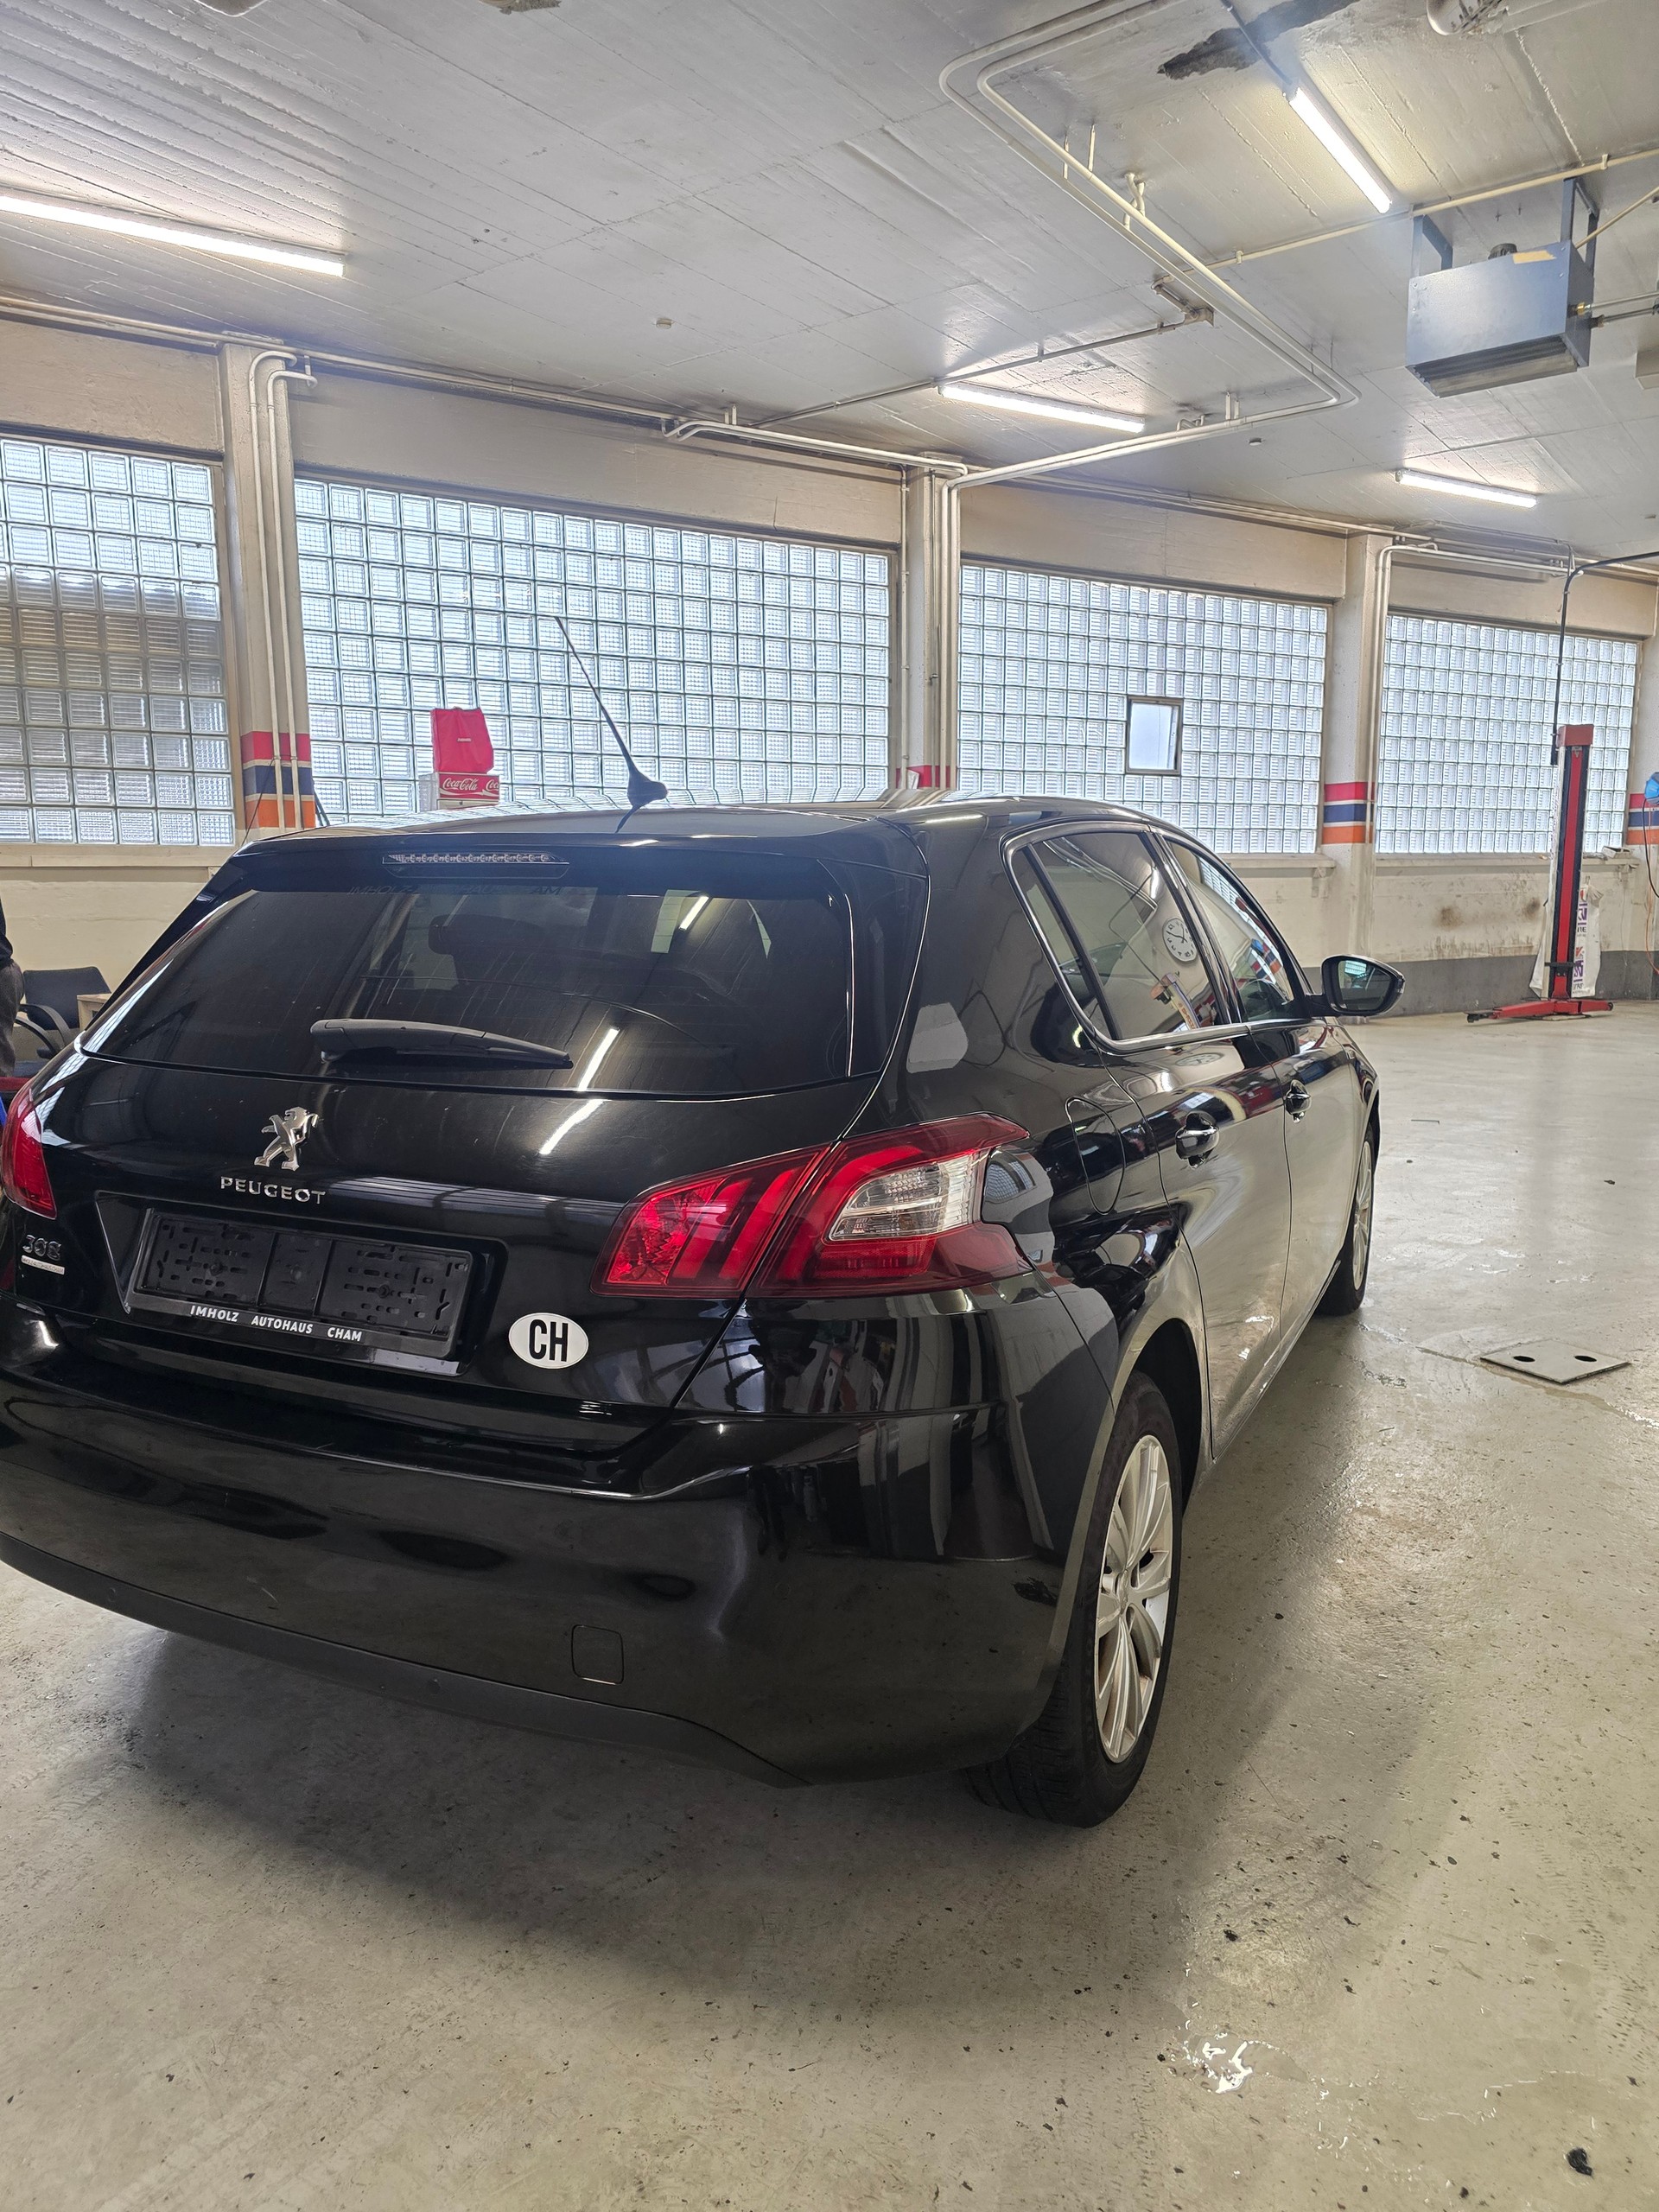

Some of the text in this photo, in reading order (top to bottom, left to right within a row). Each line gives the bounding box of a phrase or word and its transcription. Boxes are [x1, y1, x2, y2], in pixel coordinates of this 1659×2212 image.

[220, 1176, 327, 1205] PEUGEOT
[190, 1305, 362, 1342] IMHOLZ AUTOHAUS CHAM
[529, 1319, 569, 1363] CH
